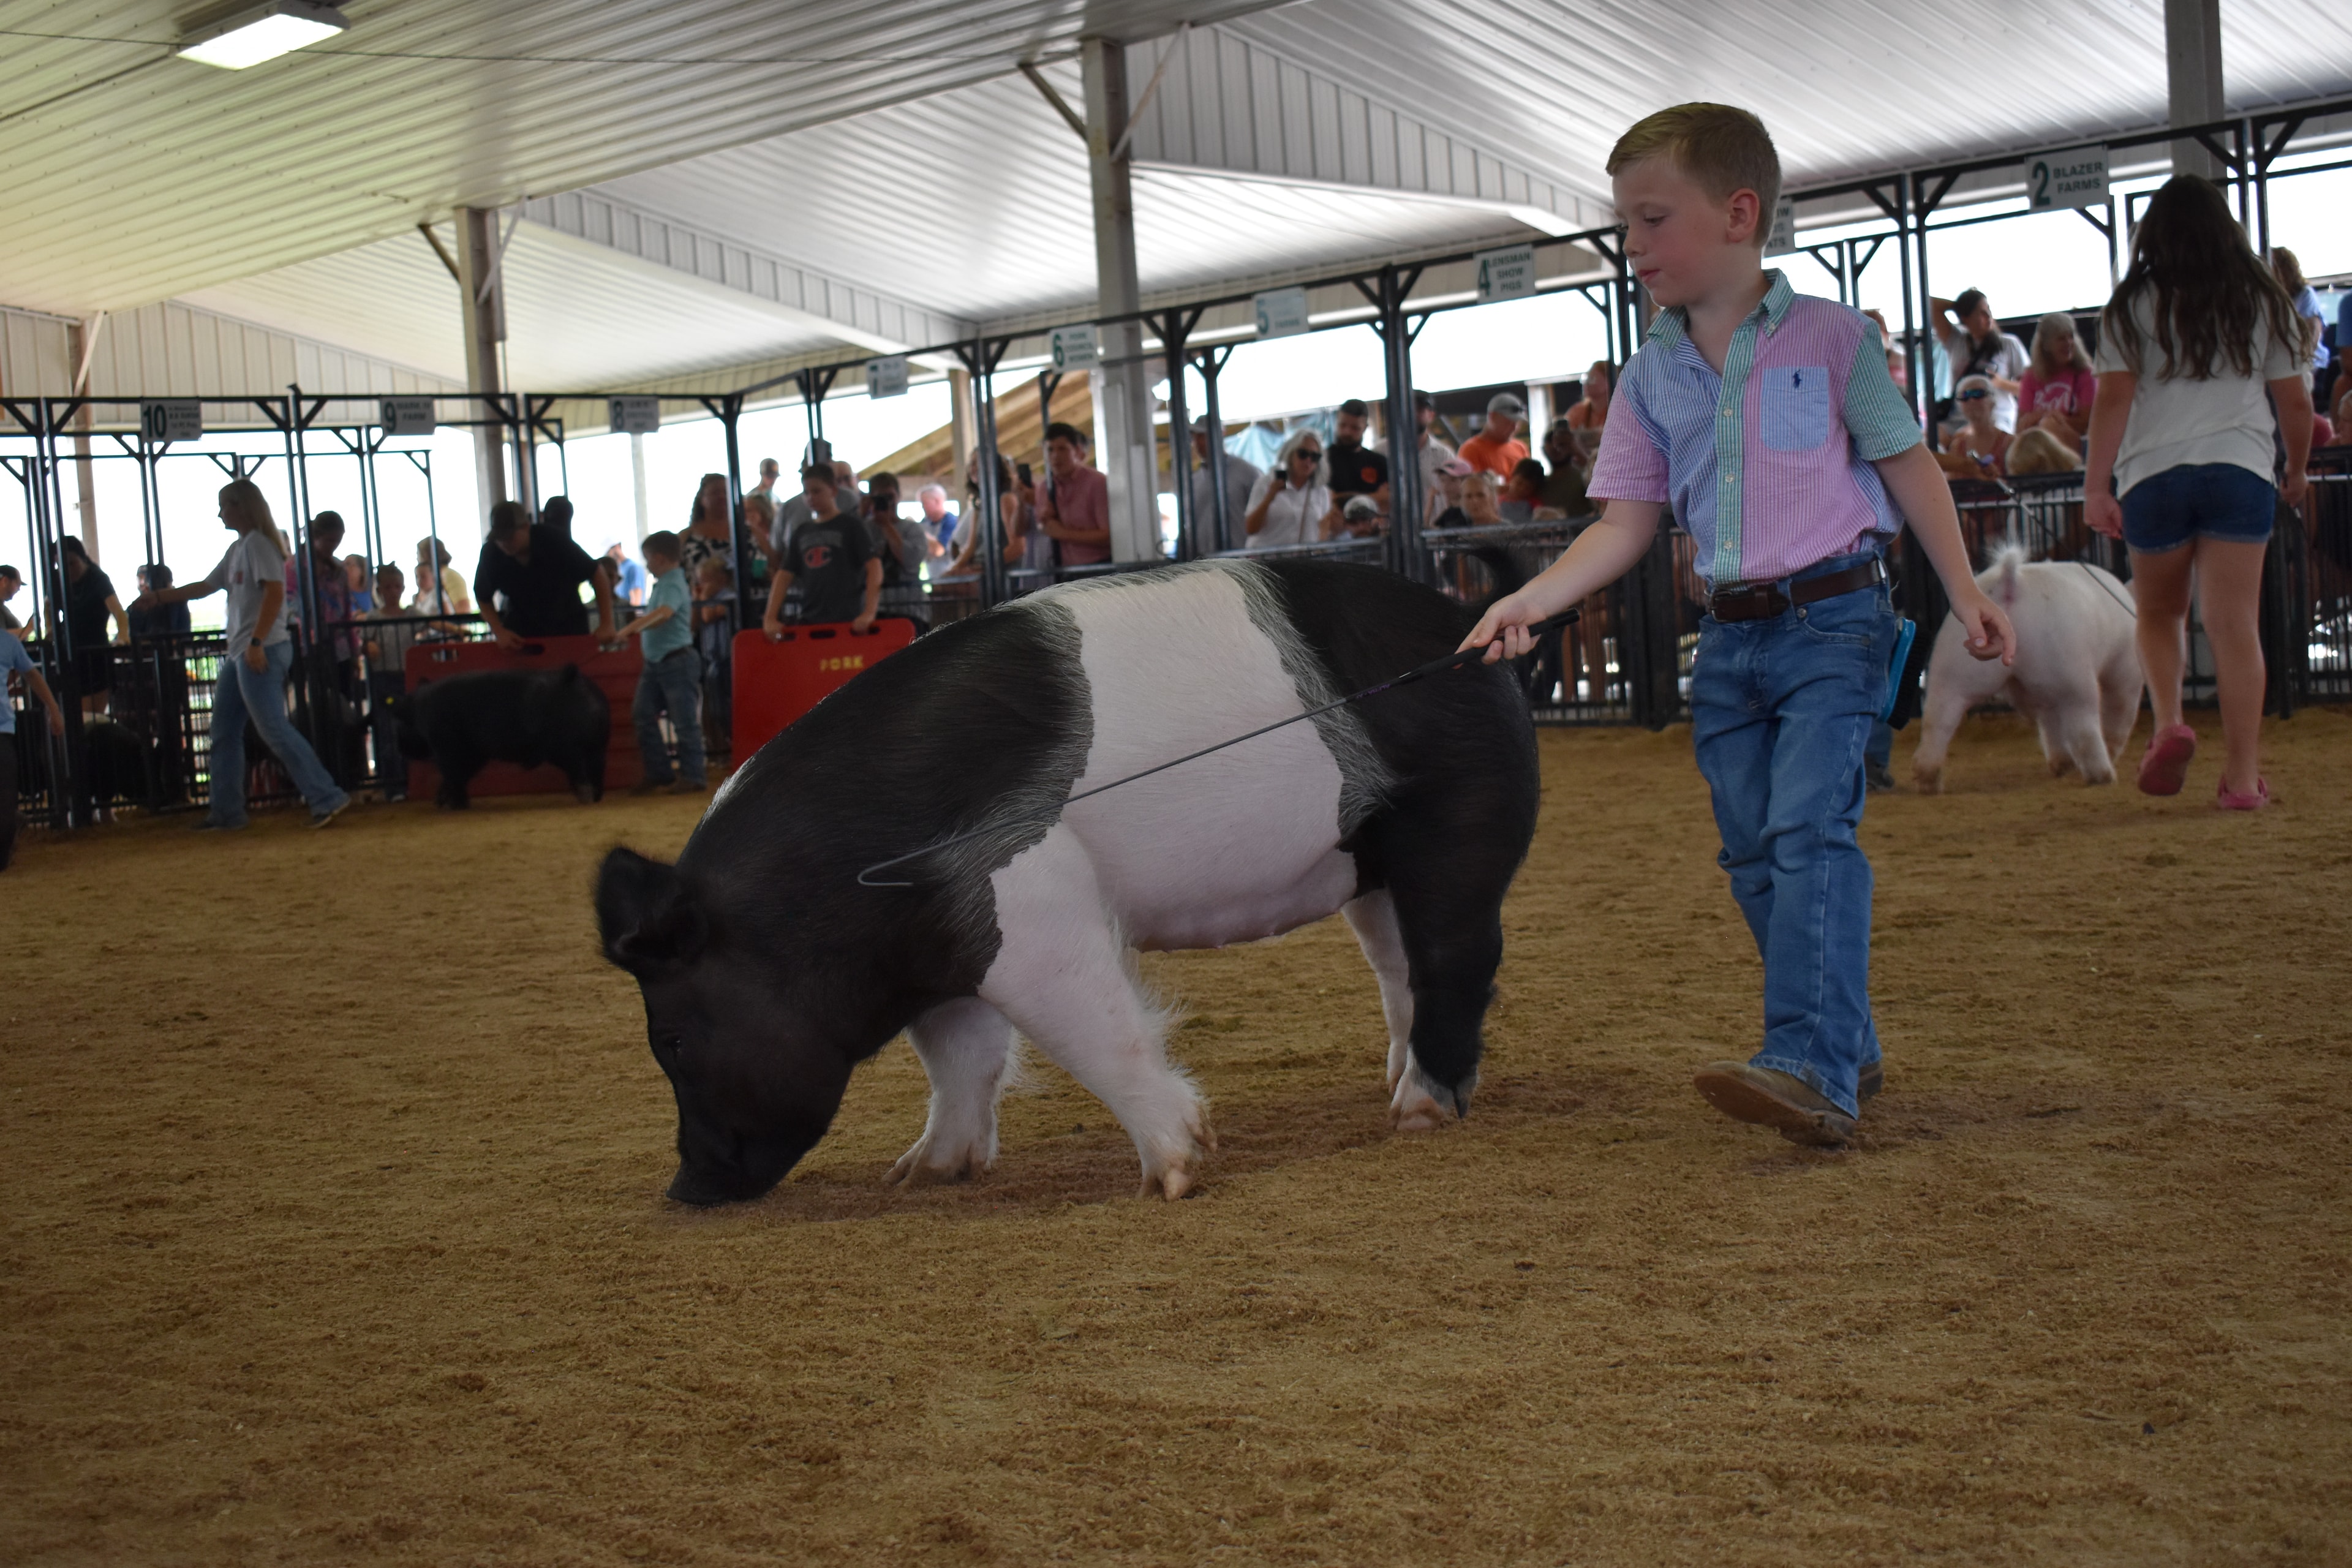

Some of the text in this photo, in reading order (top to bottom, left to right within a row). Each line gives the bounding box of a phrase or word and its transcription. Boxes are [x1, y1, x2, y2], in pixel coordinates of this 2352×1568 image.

[2032, 161, 2051, 206] 2
[2052, 162, 2103, 179] BLAZER
[2057, 177, 2100, 194] FARMS
[1478, 259, 1491, 297] 4
[1496, 266, 1523, 279] SHOW
[1500, 280, 1521, 292] PIGS
[1256, 298, 1268, 335] 5
[1053, 334, 1065, 367] 6
[143, 404, 167, 439] 10
[384, 401, 396, 433] 9
[613, 401, 625, 431] 8
[820, 655, 864, 671] PORK
